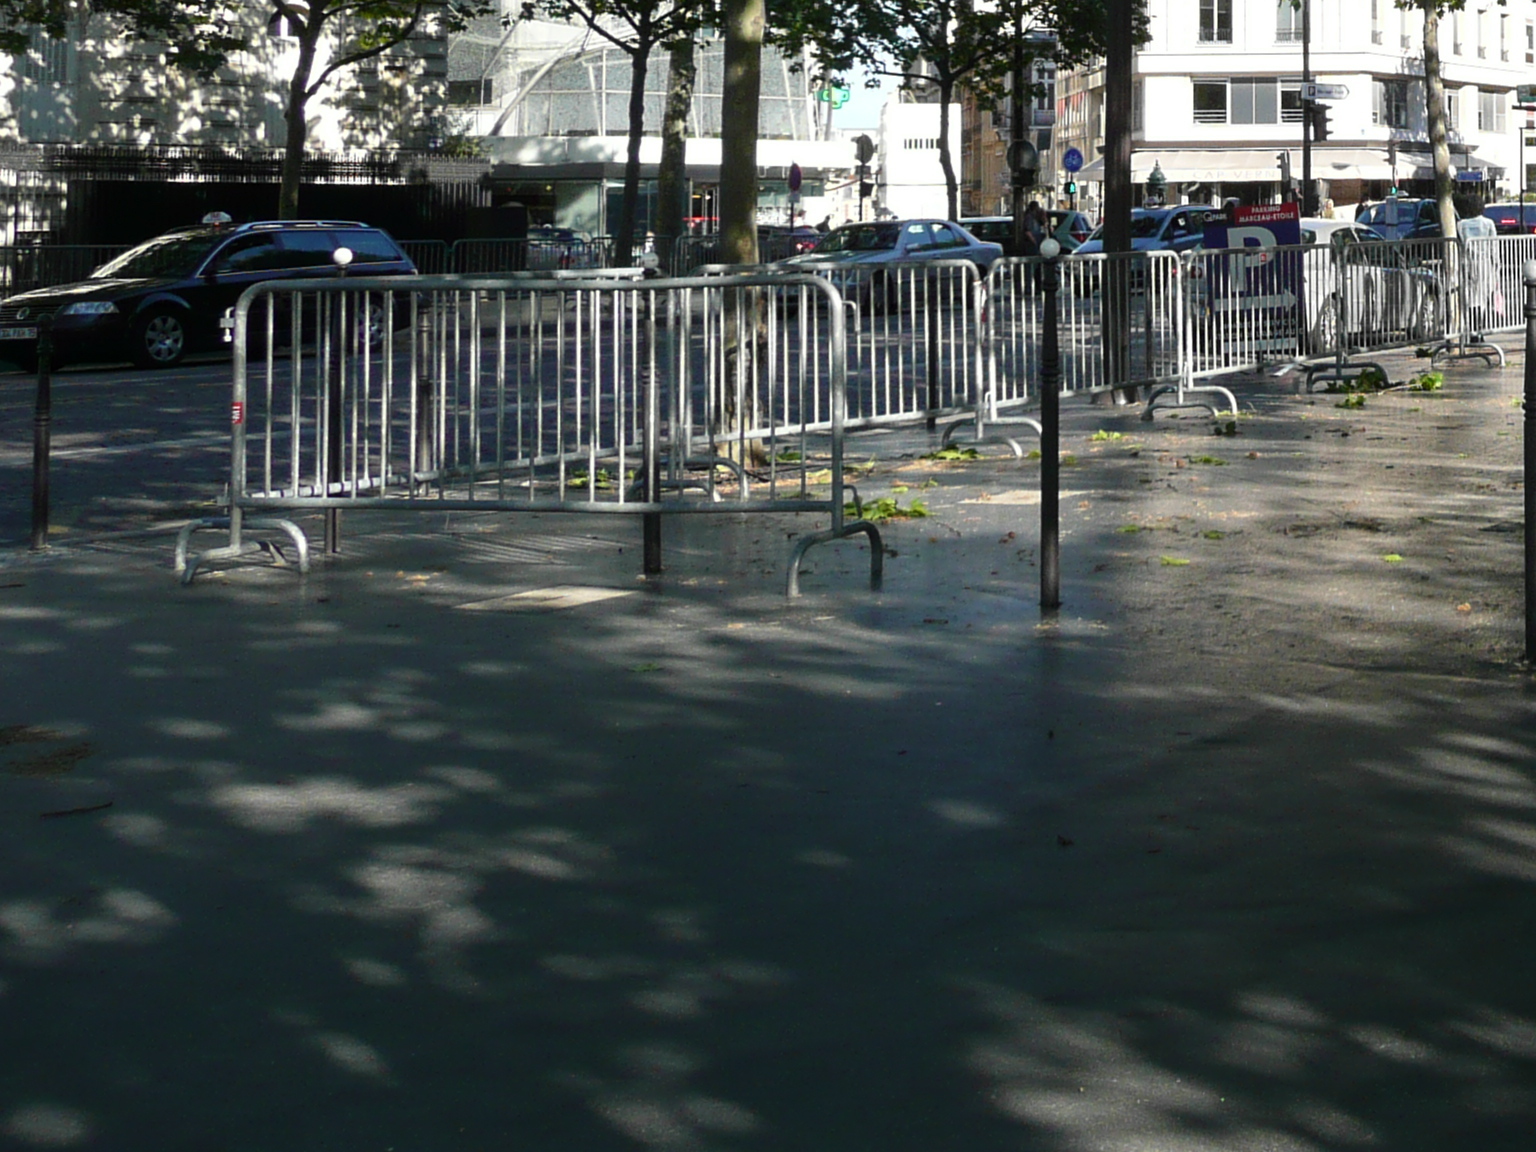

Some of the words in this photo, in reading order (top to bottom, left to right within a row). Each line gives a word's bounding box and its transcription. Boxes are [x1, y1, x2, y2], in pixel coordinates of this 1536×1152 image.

[1192, 171, 1225, 179] CAP
[1233, 170, 1281, 179] VERN
[1251, 205, 1281, 214] PARKING
[1239, 212, 1294, 223] MARCEAU-ETOILE
[1227, 226, 1277, 291] P
